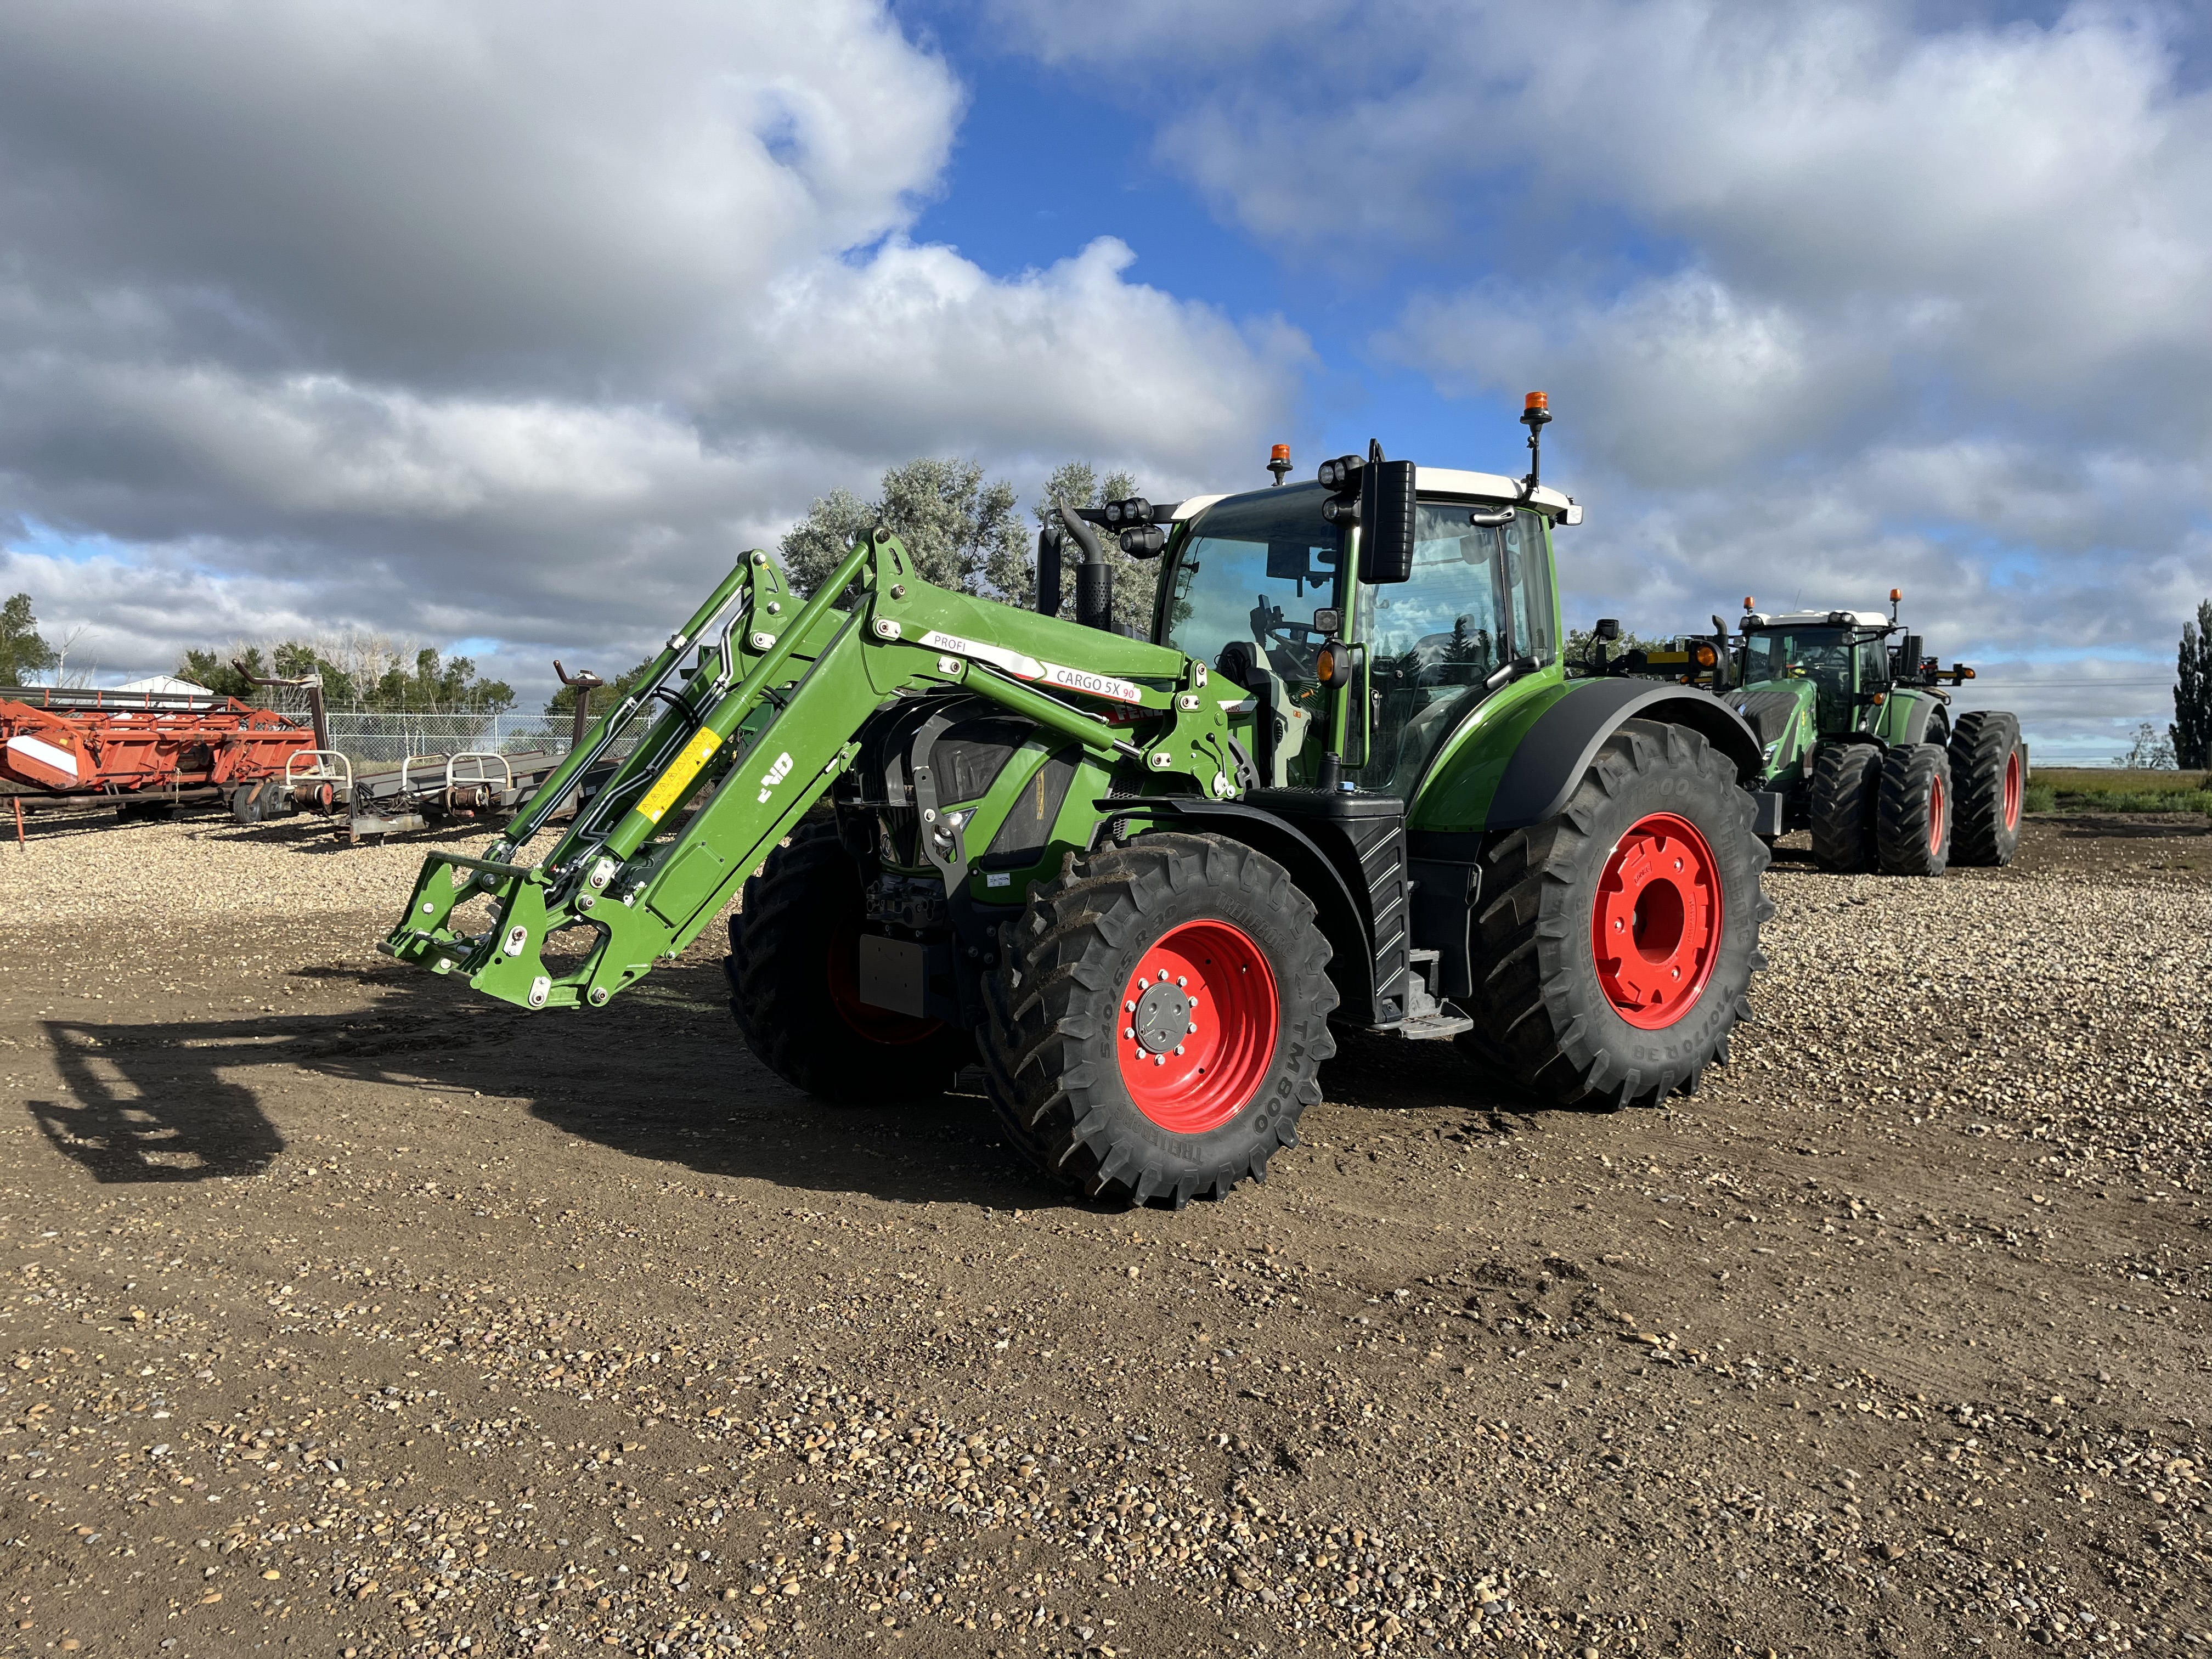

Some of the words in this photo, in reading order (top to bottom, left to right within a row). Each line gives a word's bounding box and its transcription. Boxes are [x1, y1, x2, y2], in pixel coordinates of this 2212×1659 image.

[934, 635, 966, 652] PROFI
[1057, 670, 1101, 690] CARGO
[1105, 682, 1120, 695] 5X
[1123, 689, 1134, 698] 90
[1720, 814, 1751, 945] TRELLEBORG
[1216, 889, 1295, 958] TRELLEBORG
[1253, 1020, 1308, 1135] TM800
[1114, 1103, 1204, 1166] TRELLEBORG
